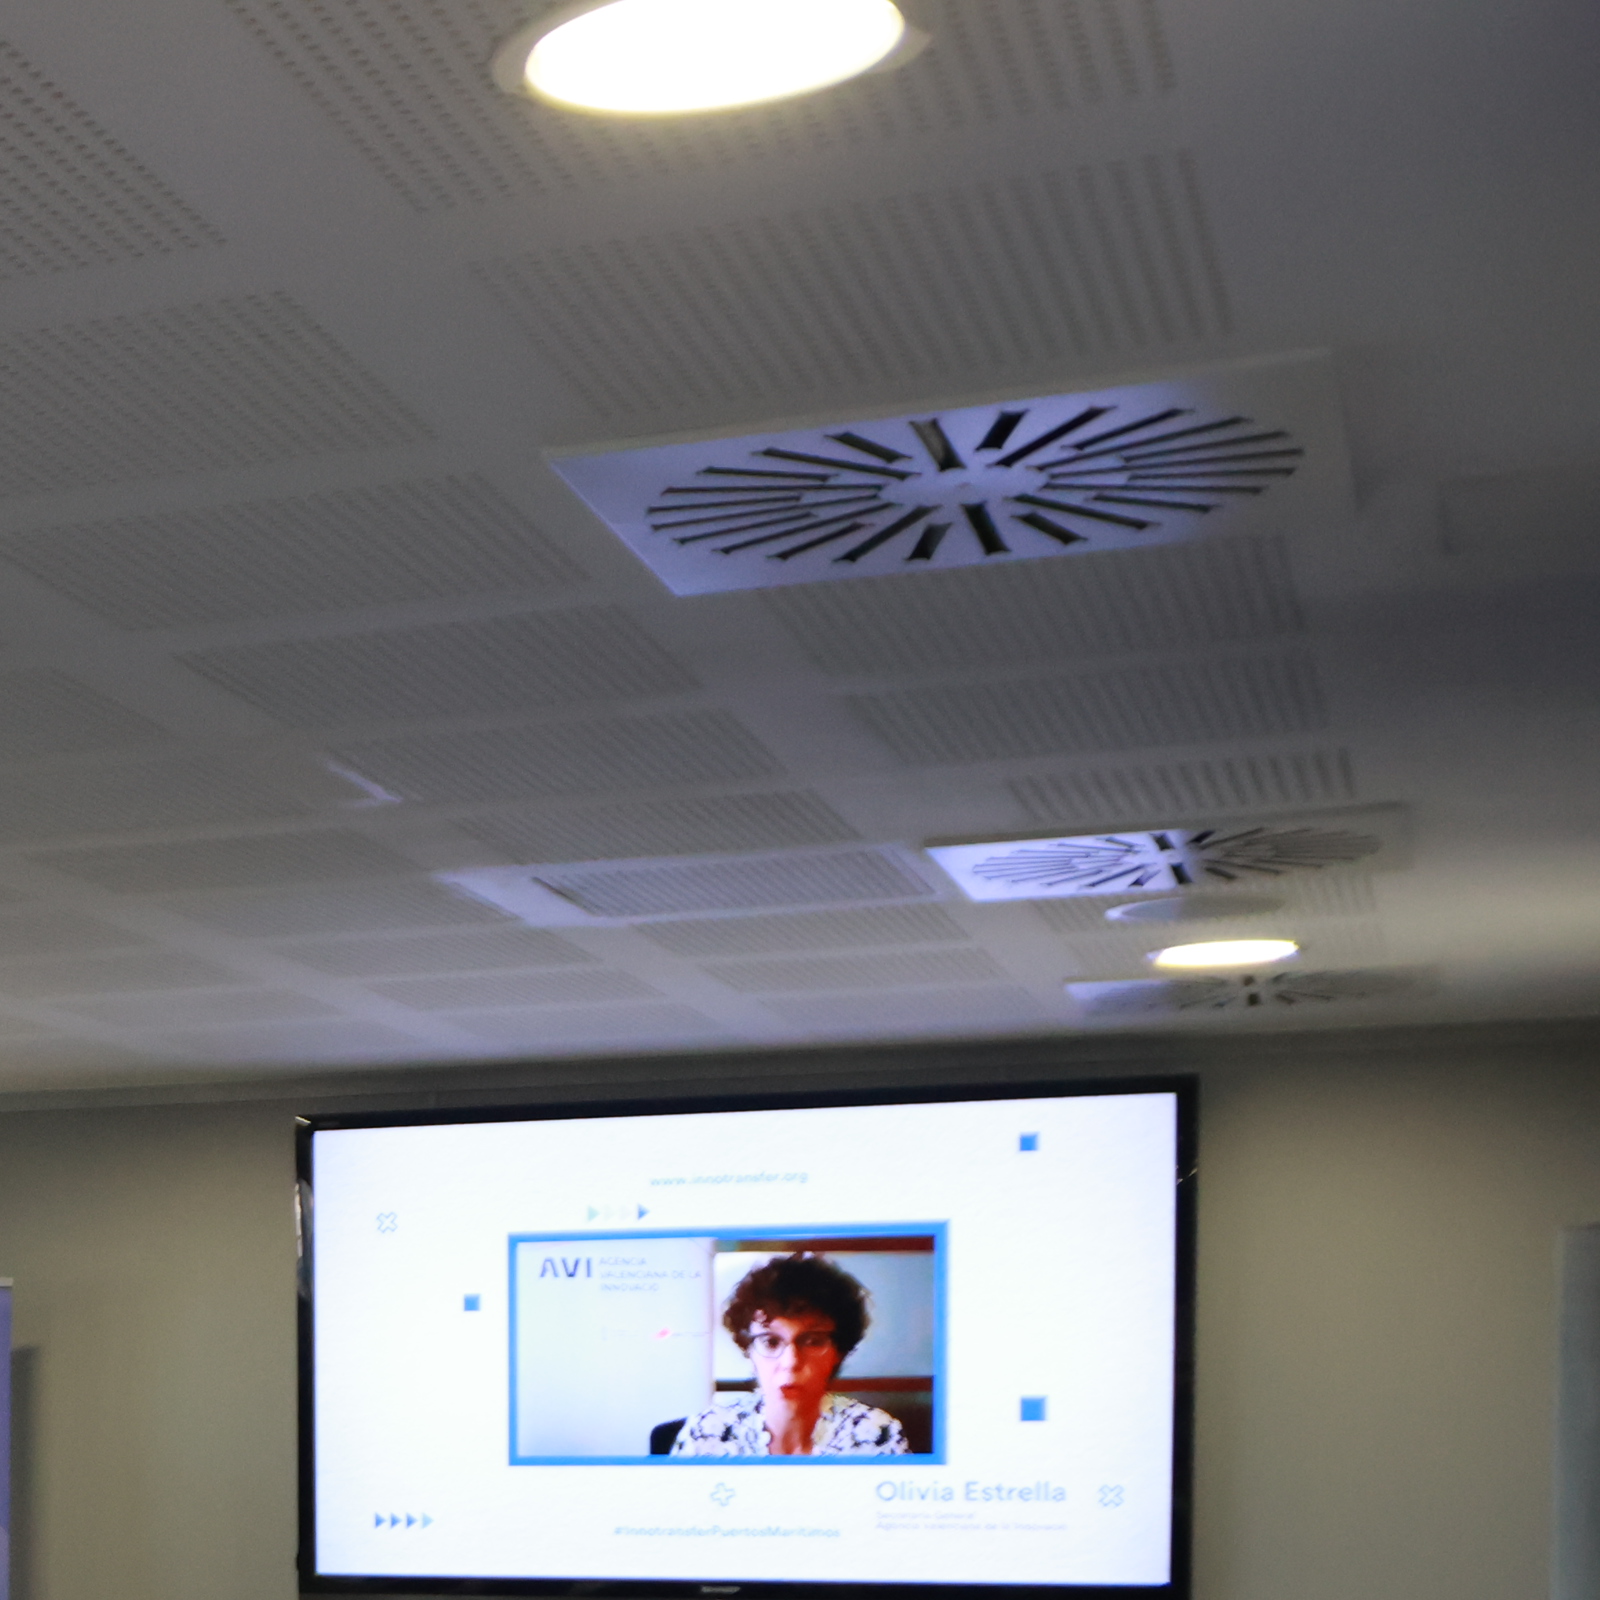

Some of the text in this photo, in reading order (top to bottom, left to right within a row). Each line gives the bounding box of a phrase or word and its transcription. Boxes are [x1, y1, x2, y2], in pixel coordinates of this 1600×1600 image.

[539, 1257, 593, 1278] AVI
[876, 1481, 1066, 1501] Olivia Estrella
